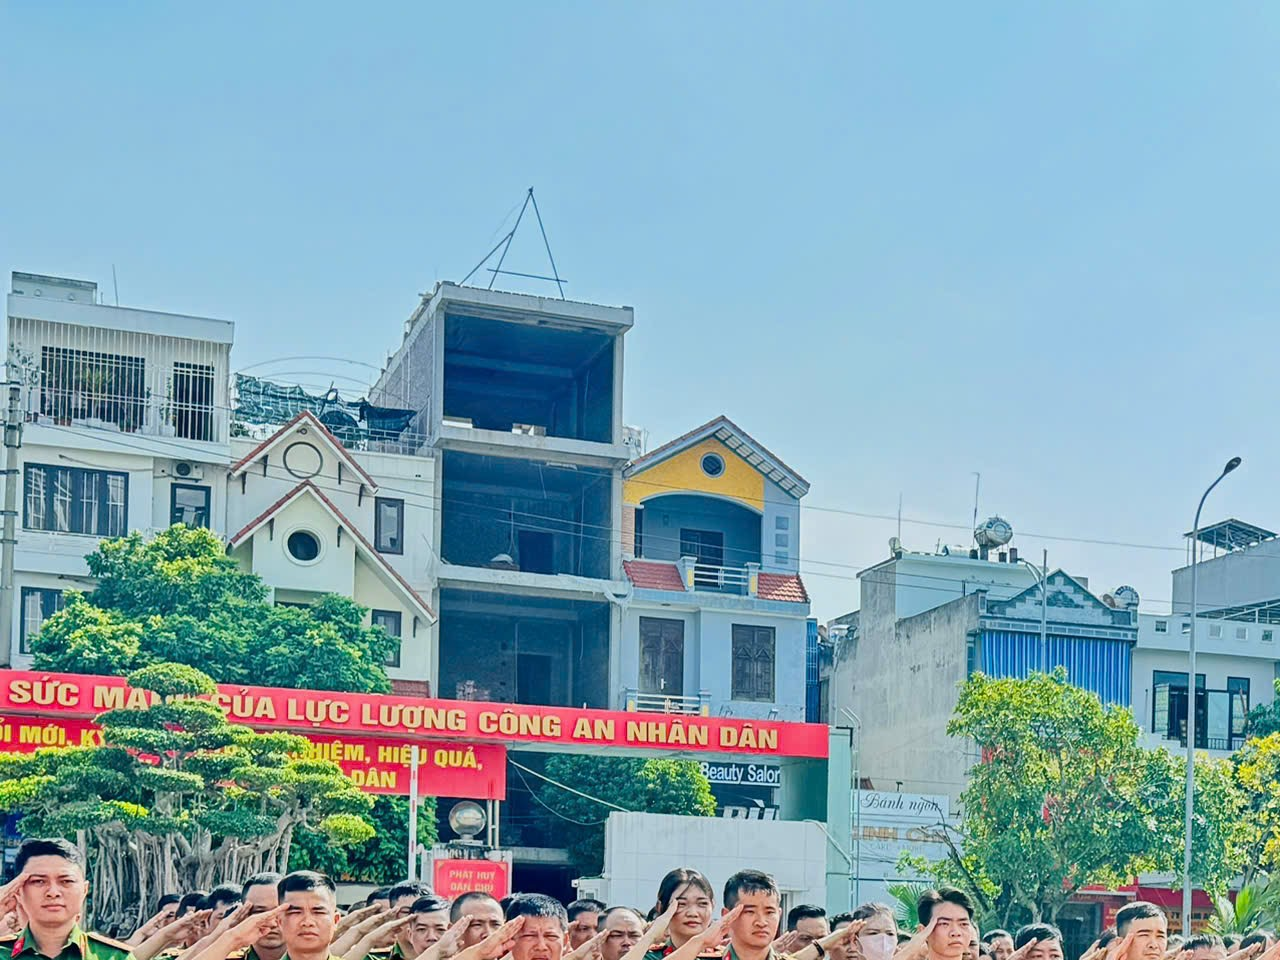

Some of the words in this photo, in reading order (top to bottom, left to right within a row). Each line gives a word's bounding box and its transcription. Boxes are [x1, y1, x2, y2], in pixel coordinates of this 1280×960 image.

[9, 676, 79, 707] SỨC
[211, 688, 276, 719] CỦA
[288, 698, 349, 727] LỰC
[361, 703, 466, 733] LƯỢNG
[479, 708, 561, 737] CÔNG
[572, 718, 615, 740] AN
[627, 719, 708, 745] NHÂN
[720, 723, 778, 750] DÂN
[19, 723, 73, 747] MỚI,
[434, 746, 482, 770] QUẢ,
[351, 768, 396, 789] DÂN
[700, 762, 744, 784] Beauty
[860, 792, 904, 810] Bánh
